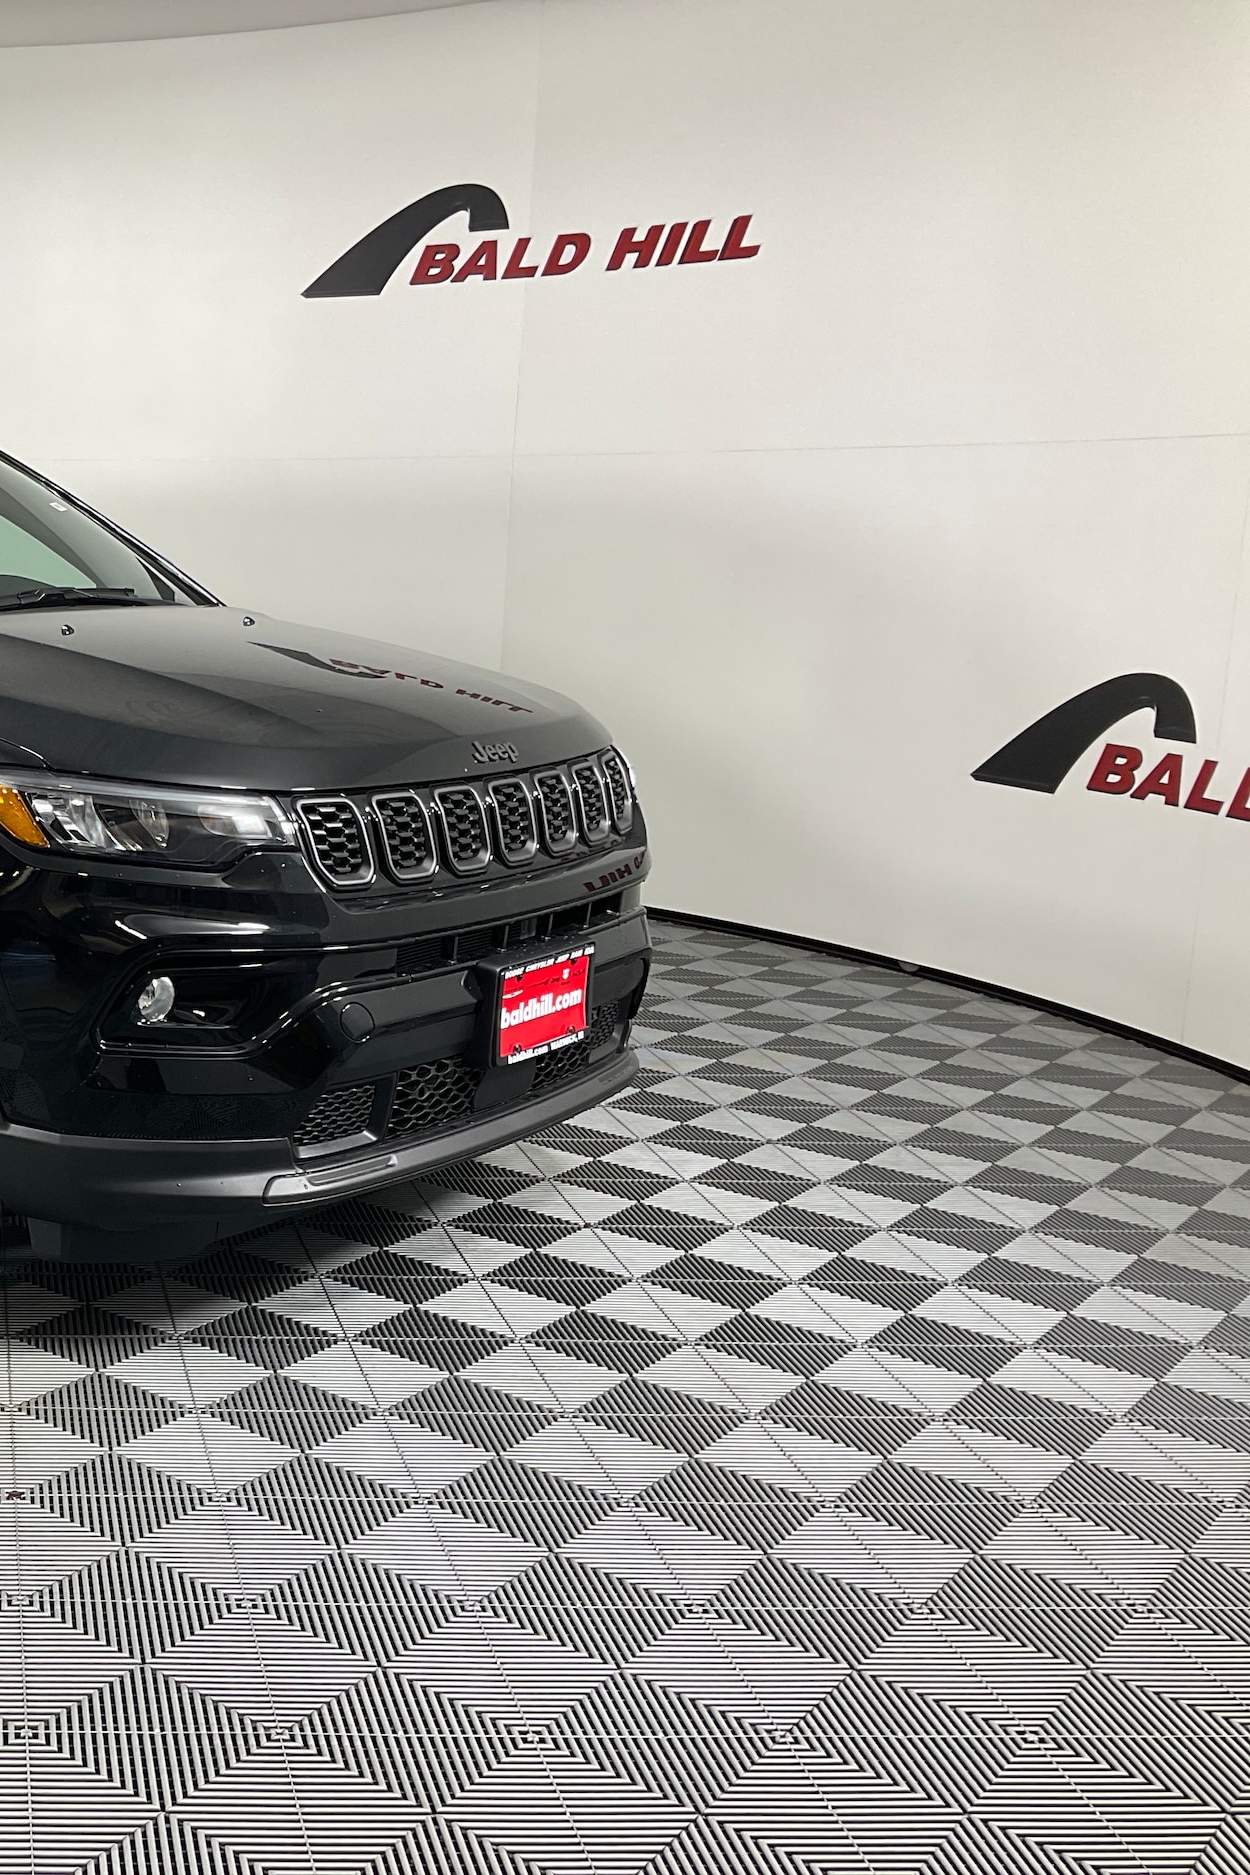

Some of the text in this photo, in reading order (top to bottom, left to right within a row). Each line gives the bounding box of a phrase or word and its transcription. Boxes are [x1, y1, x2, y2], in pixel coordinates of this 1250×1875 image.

[409, 214, 762, 285] BALD HILL
[471, 741, 519, 763] Jeep
[505, 946, 594, 979] DODGE CHRYSLER JEEP RAM KIA
[501, 989, 582, 1029] baldhill.com
[508, 1046, 548, 1064] baldhill.com
